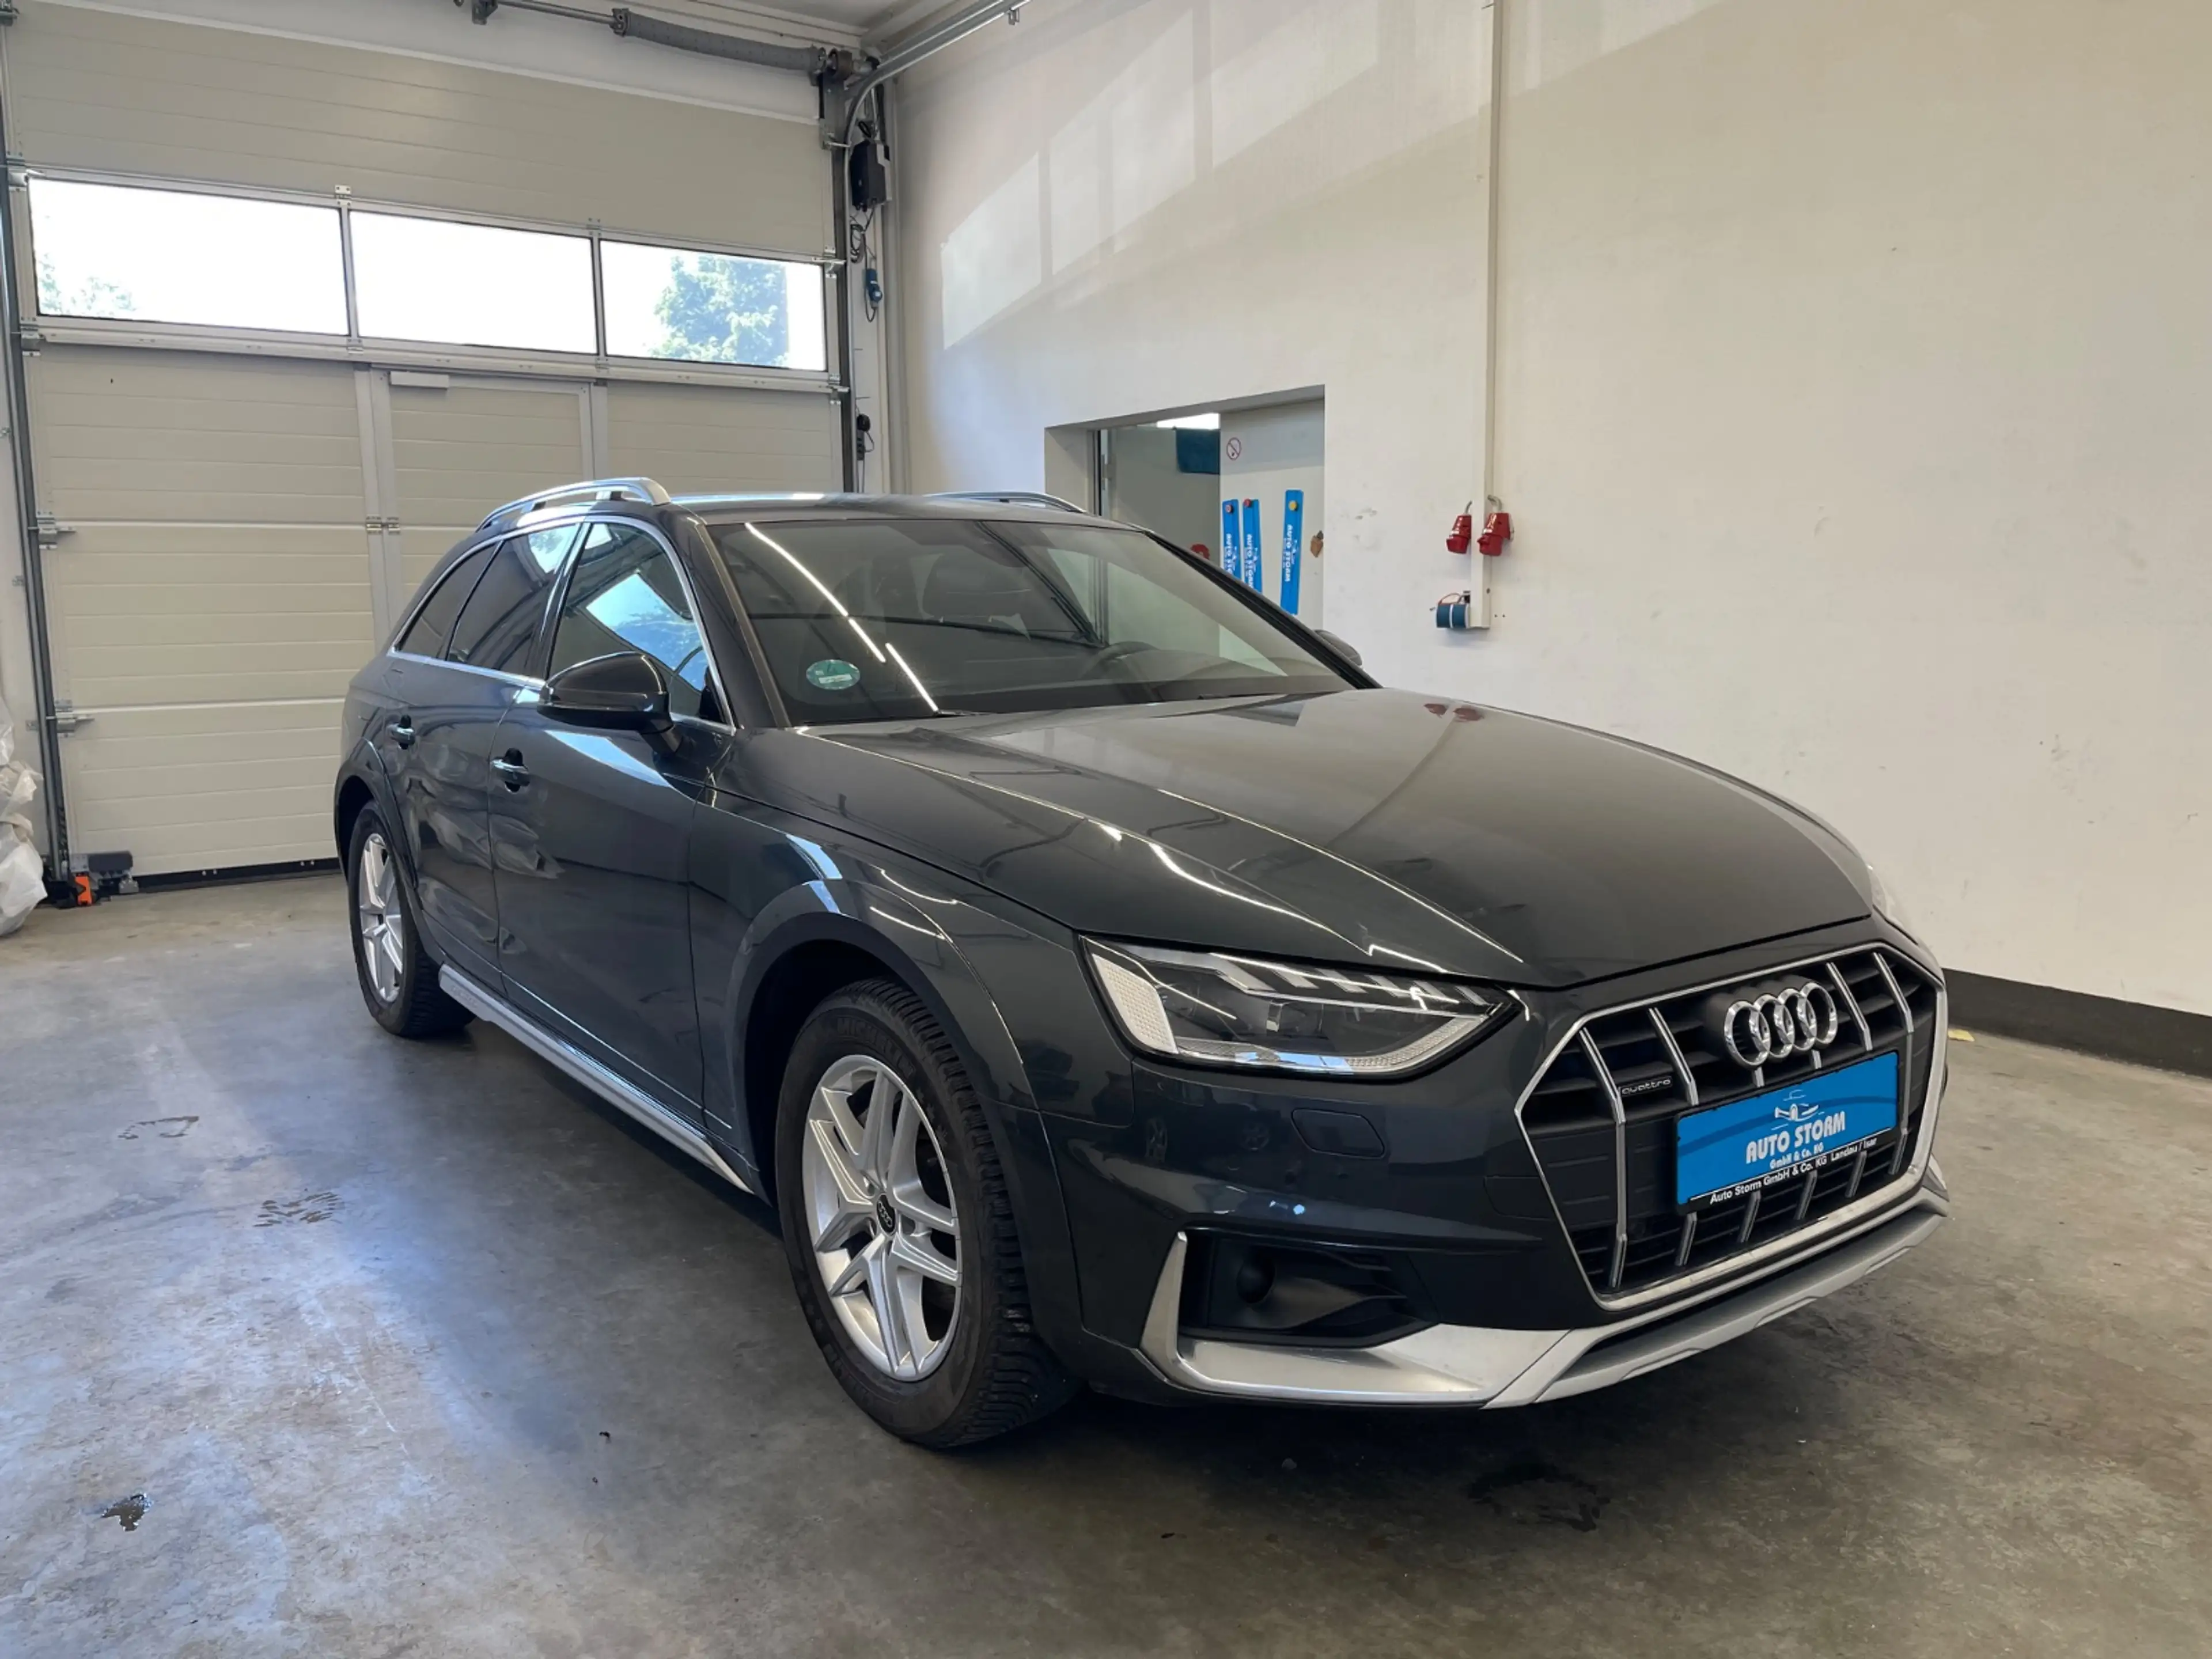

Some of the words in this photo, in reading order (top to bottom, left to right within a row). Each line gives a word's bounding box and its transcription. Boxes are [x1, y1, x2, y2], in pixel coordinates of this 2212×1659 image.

[837, 1017, 915, 1078] MICHELIN
[1622, 1079, 1671, 1094] quattro
[1746, 1131, 1790, 1164] AUTO
[1794, 1111, 1845, 1148] STORM
[1710, 1190, 1733, 1205] Auto
[1735, 1180, 1762, 1196] Storm
[1763, 1168, 1790, 1185] GmbH
[1792, 1164, 1799, 1176] &
[1800, 1162, 1813, 1173] Co.
[1816, 1155, 1827, 1168] KG
[1831, 1145, 1858, 1162] Landau
